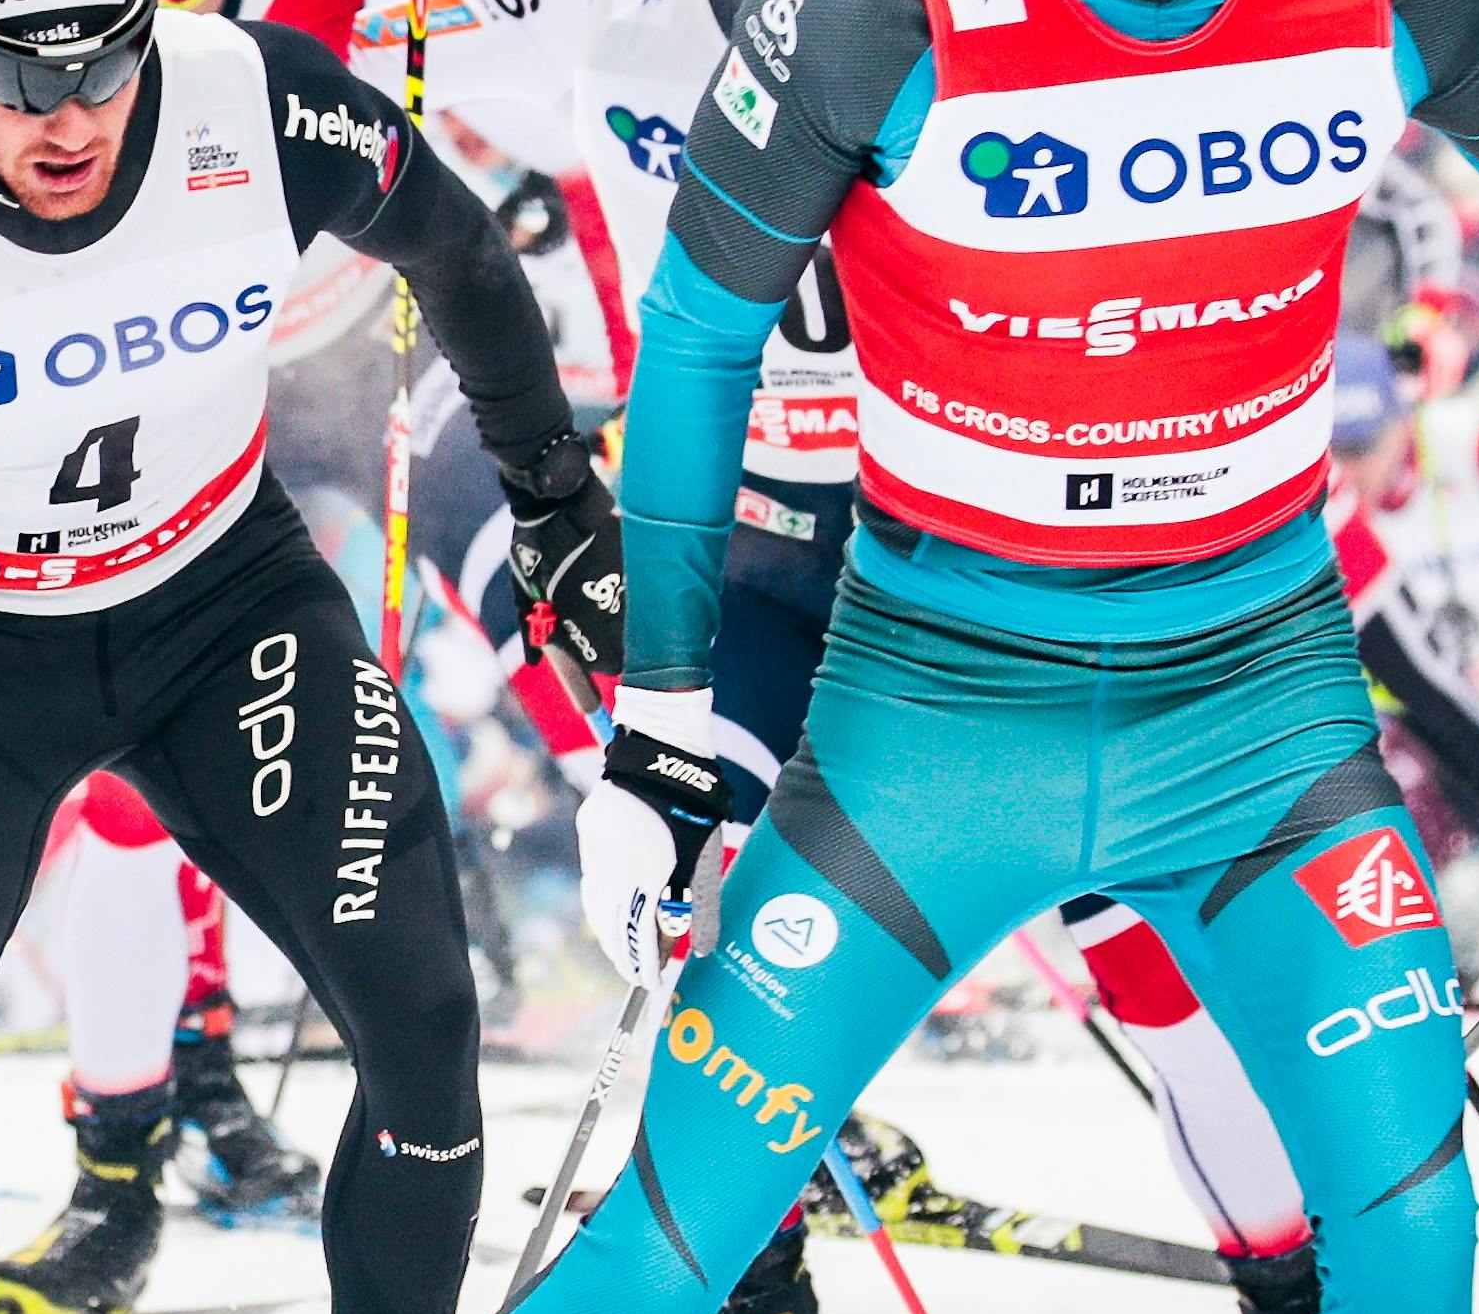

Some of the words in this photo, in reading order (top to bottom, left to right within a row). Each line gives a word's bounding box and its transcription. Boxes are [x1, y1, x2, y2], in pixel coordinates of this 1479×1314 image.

[1120, 109, 1367, 203] OBOS
[45, 283, 273, 387] OBOS
[948, 269, 1325, 357] VIESSMANN
[902, 380, 941, 414] FIS
[944, 399, 1218, 446] CROSS-COUNTRY
[1222, 373, 1309, 430] WORLD
[48, 414, 142, 513] 4
[1121, 466, 1231, 490] HOLMENKOLLEN
[1121, 484, 1207, 503] SKIFESTIVAL
[332, 657, 402, 926] RAIFFEISEN
[399, 1134, 481, 1165] swisscom
